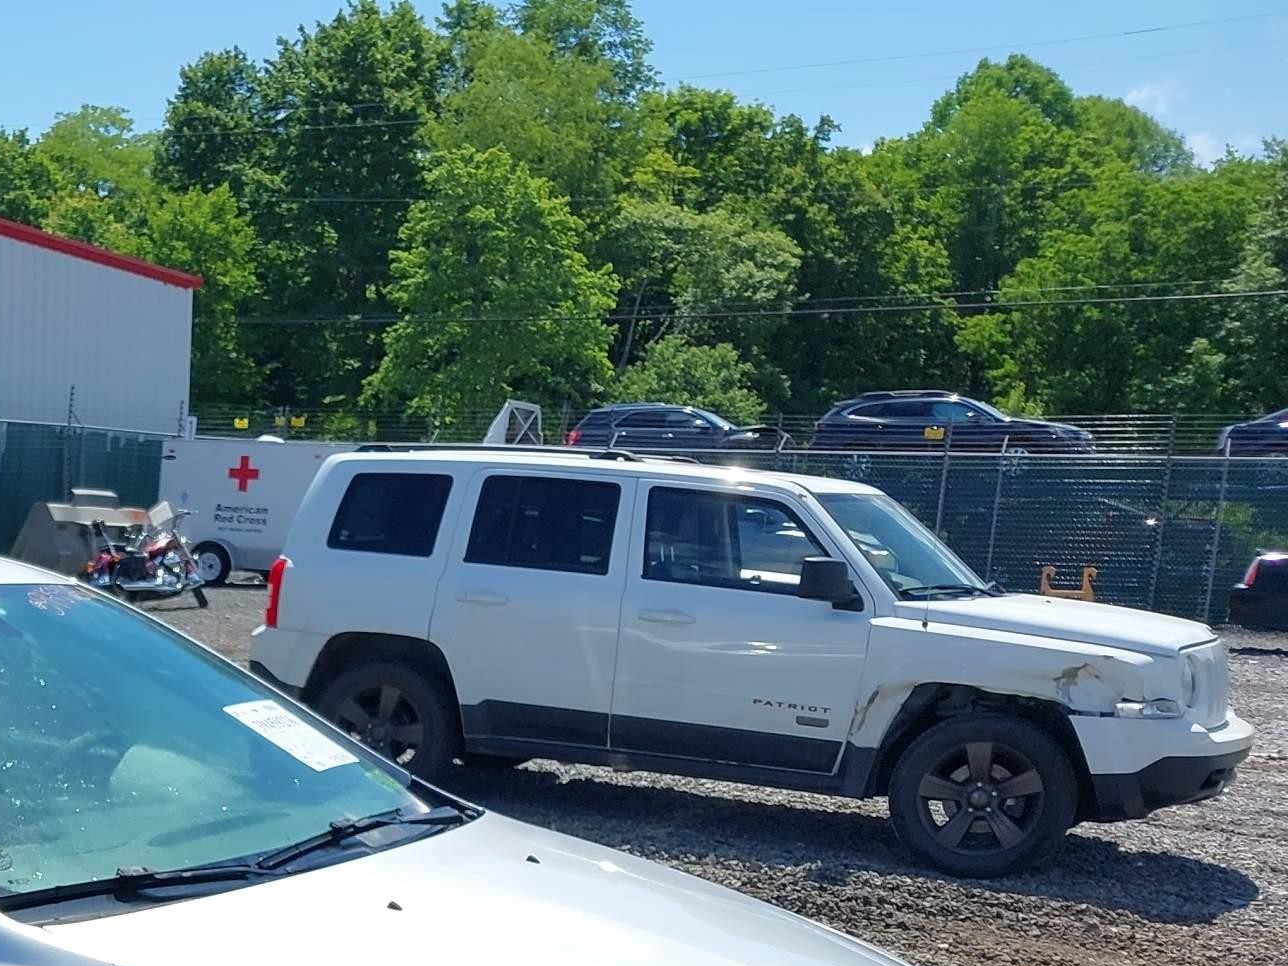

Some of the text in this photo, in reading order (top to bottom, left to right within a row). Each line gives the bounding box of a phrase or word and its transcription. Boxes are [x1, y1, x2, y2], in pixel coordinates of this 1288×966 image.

[215, 503, 269, 515] American
[214, 513, 267, 526] Red Cross
[752, 698, 832, 714] PATRIOT
